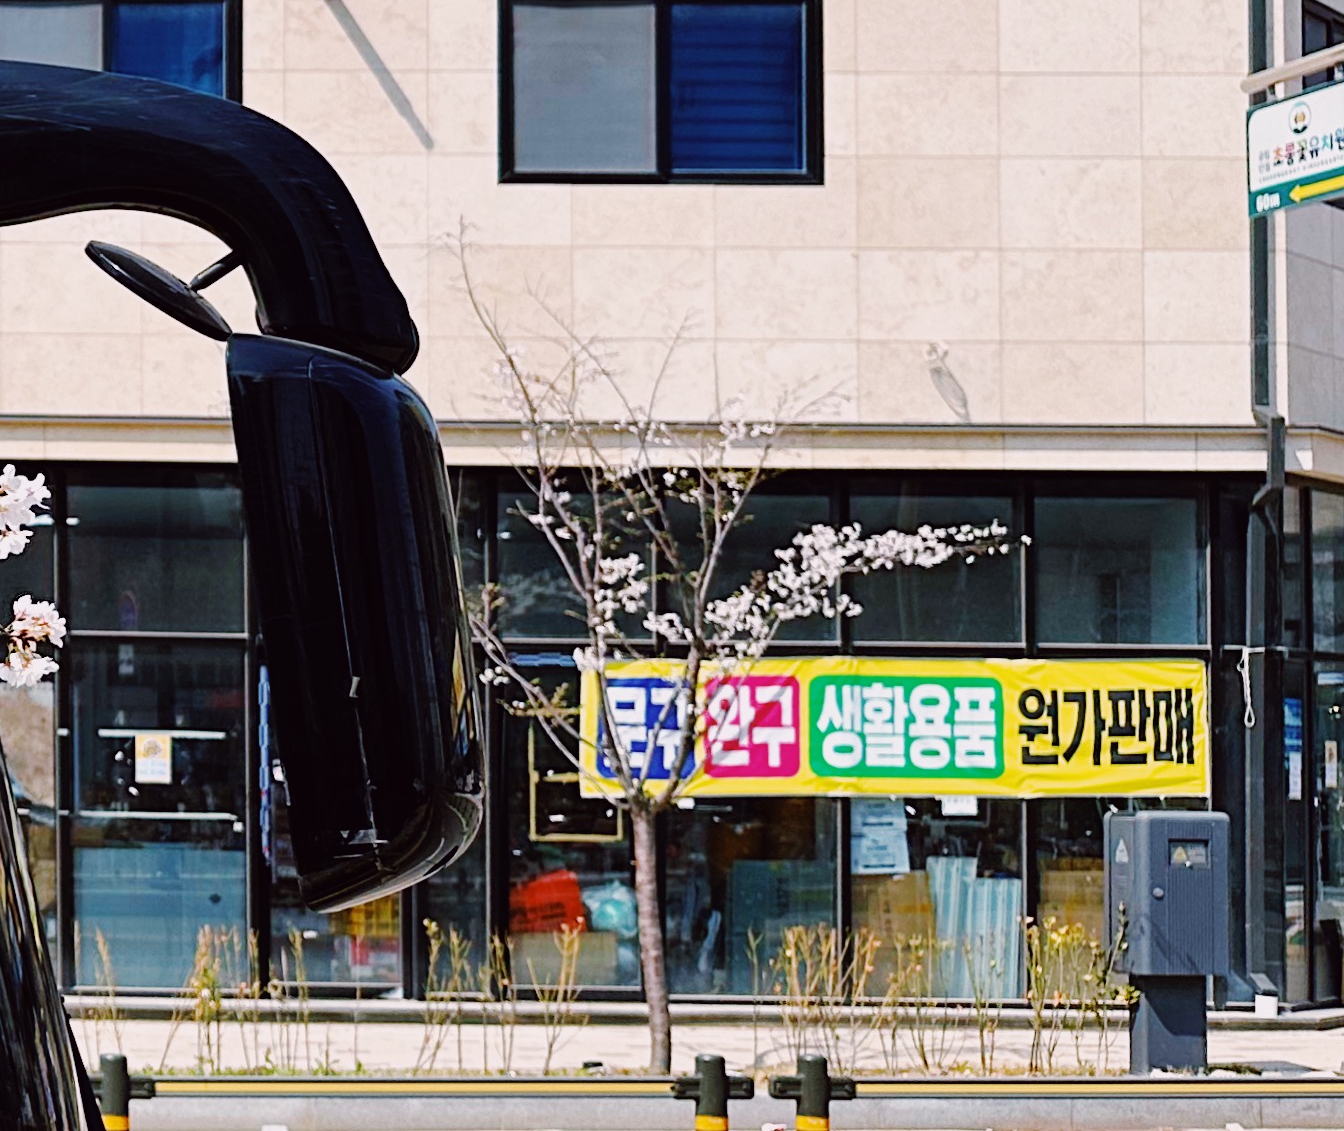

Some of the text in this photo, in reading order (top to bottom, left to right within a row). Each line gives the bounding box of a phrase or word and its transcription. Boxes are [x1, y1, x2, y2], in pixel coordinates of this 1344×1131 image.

[707, 684, 796, 768] 완구
[816, 682, 997, 770] 생활용품
[1018, 688, 1195, 766] 원가판매
